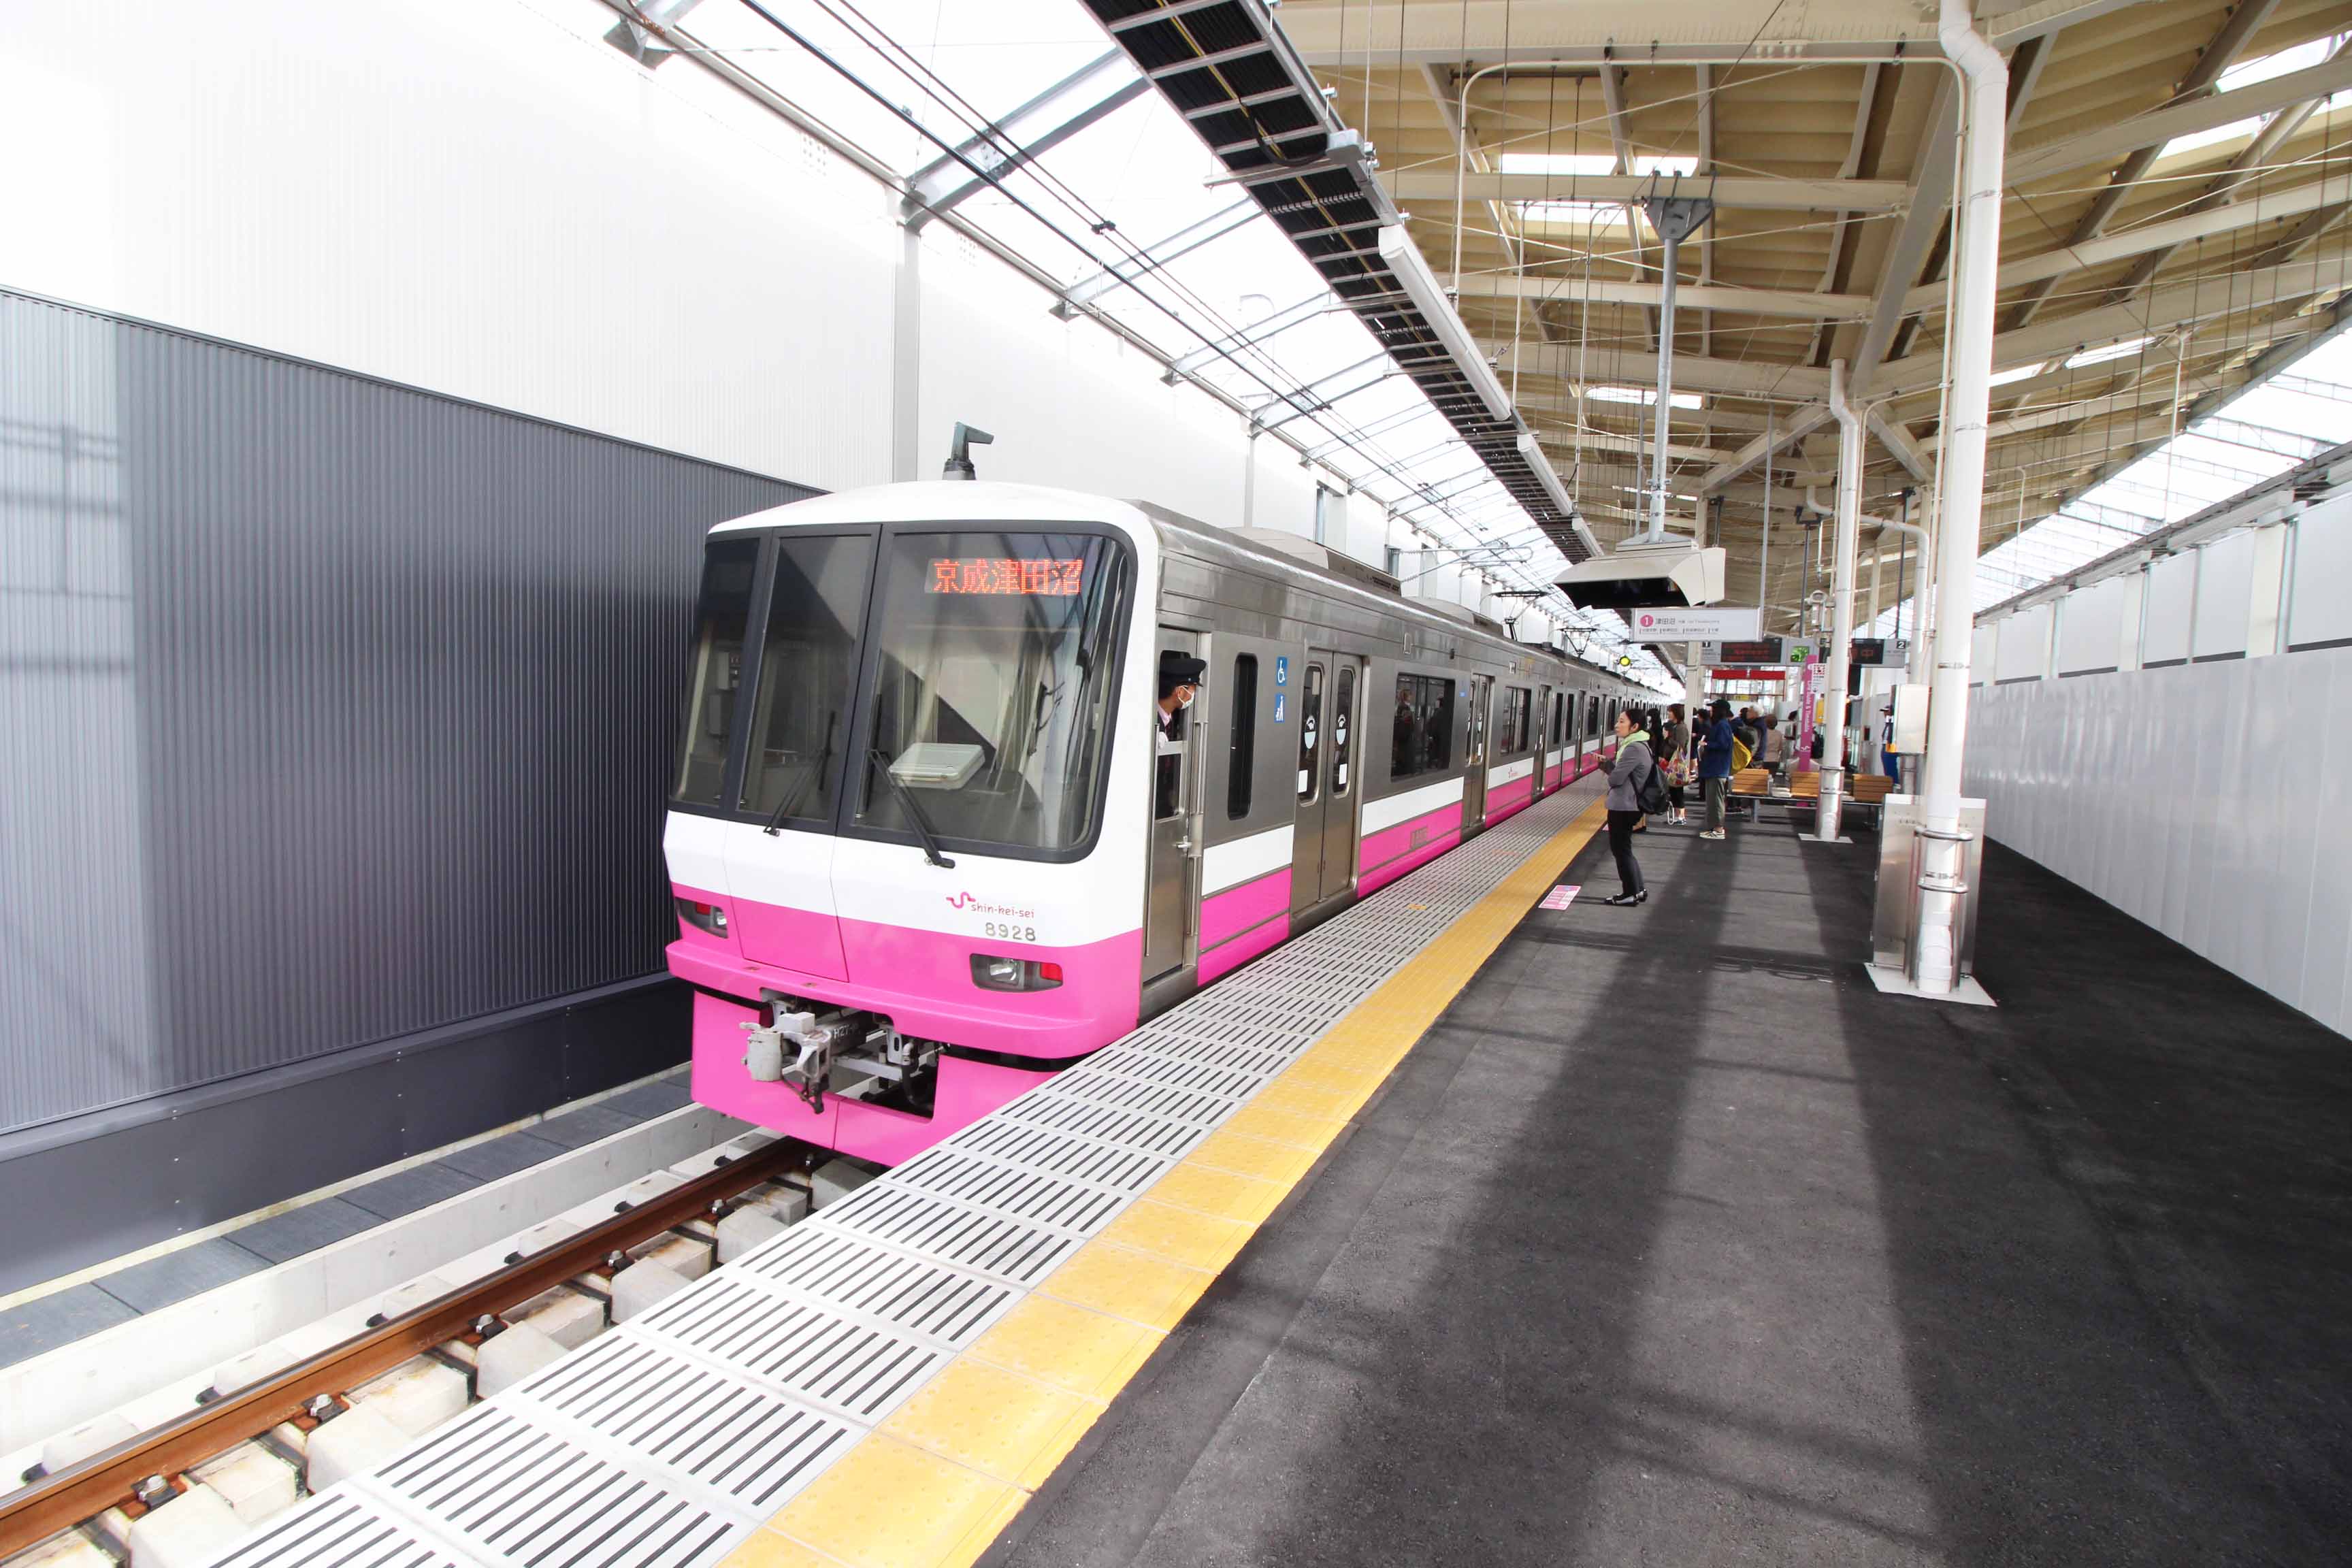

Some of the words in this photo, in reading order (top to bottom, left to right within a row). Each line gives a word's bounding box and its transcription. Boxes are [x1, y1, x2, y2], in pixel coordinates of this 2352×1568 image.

[932, 558, 1083, 595] 京成津田沼
[970, 902, 1034, 918] shin-kei-sei
[985, 922, 1036, 942] 8928
